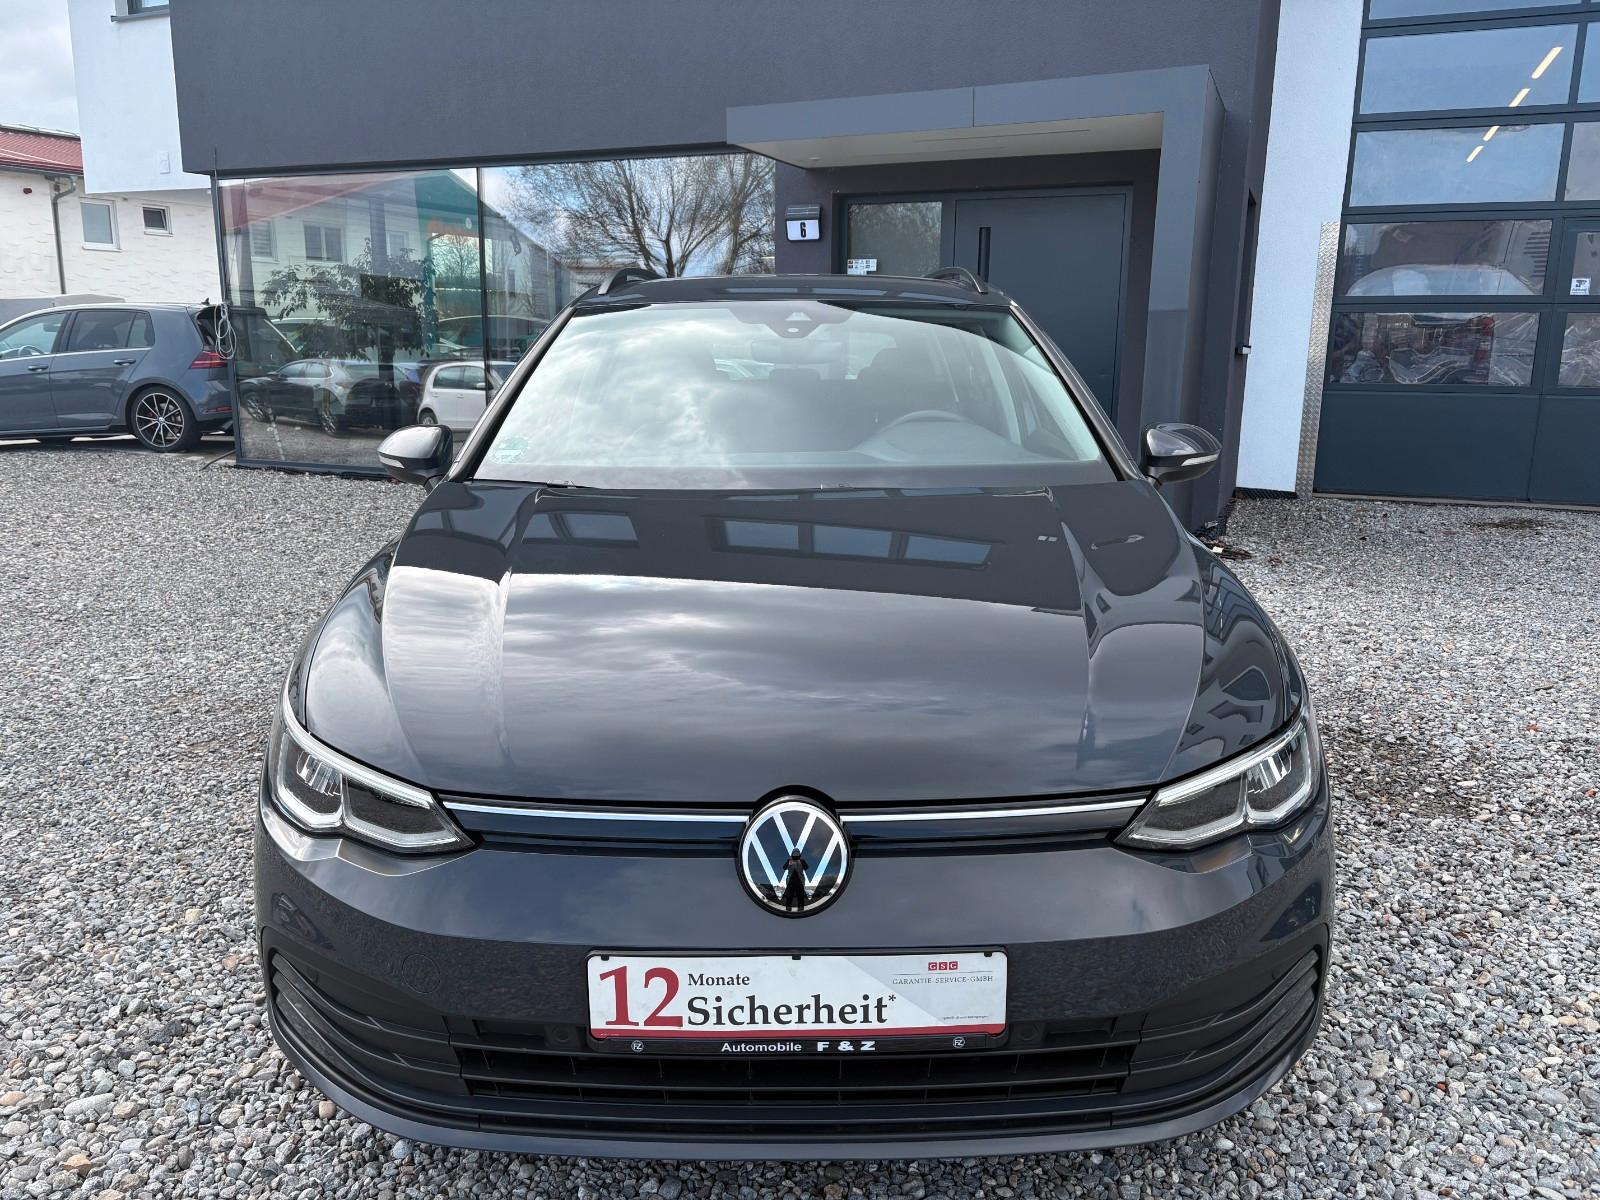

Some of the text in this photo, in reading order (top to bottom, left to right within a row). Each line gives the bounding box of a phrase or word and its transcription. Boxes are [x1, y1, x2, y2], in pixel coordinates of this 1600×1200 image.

[800, 221, 807, 238] 6
[930, 962, 958, 970] GSG
[687, 973, 751, 986] Monate
[599, 965, 684, 1028] 12
[721, 1040, 876, 1052] Automobile F & Z
